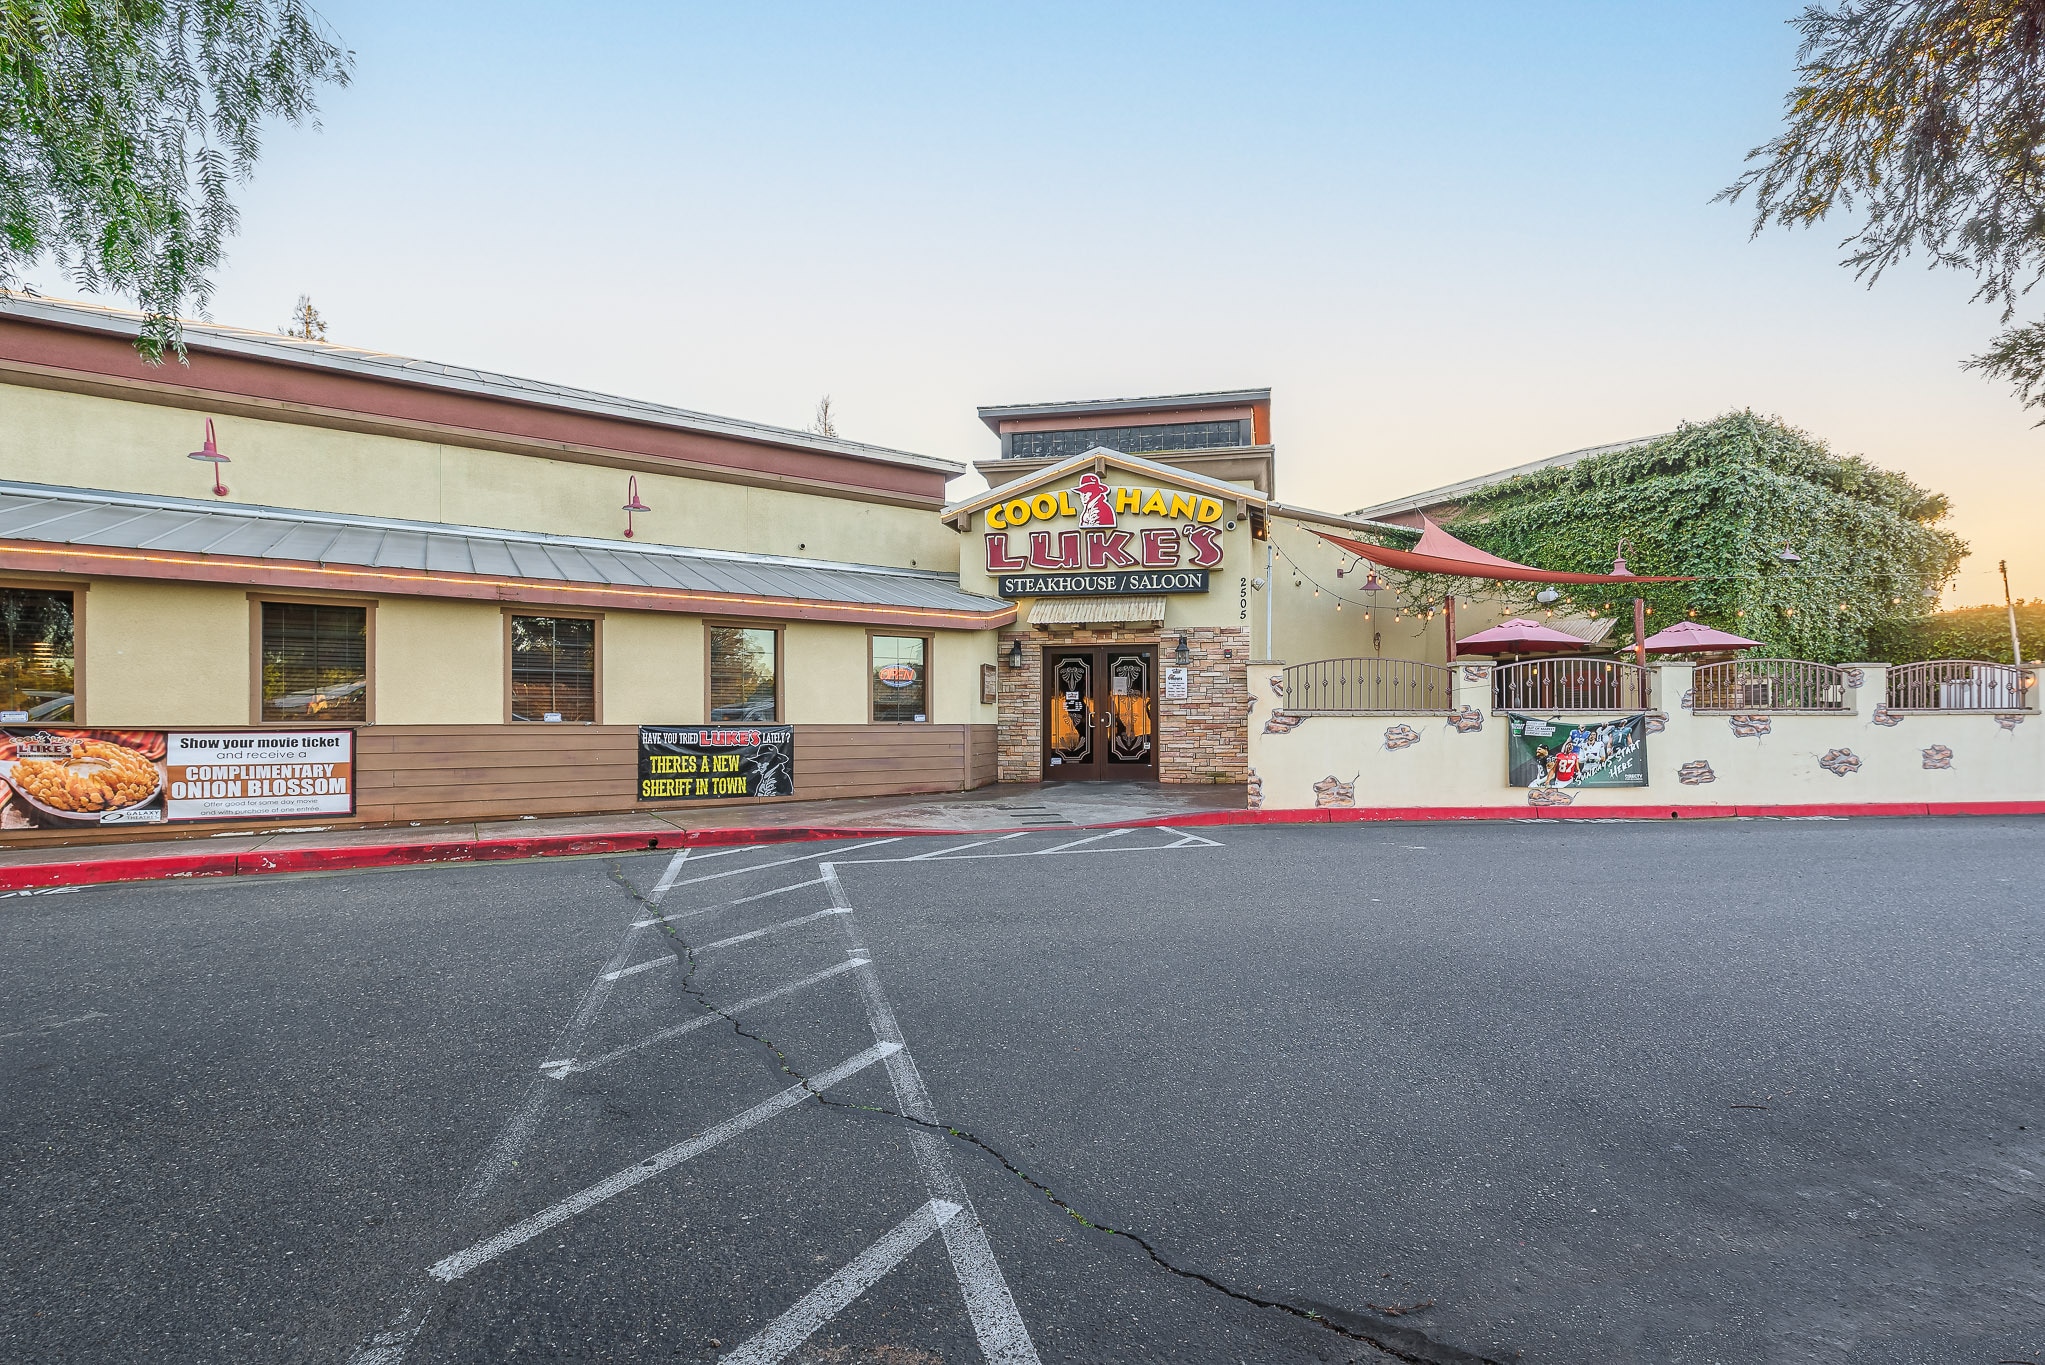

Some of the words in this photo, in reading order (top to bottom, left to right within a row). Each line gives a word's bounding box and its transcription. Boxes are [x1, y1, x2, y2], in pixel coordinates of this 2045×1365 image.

[986, 490, 1077, 529] COOL
[1115, 487, 1223, 523] HAND
[984, 524, 1223, 572] LUKE'S
[1005, 576, 1117, 593] STEAKHOUSE
[1120, 575, 1127, 591] /
[1130, 573, 1202, 590] SALOON
[879, 667, 914, 681] OPEN
[180, 737, 220, 749] Show
[222, 738, 254, 750] your
[257, 737, 299, 748] movie
[302, 736, 340, 747] ticket
[642, 732, 662, 745] HAVE
[663, 732, 678, 744] YOU
[679, 732, 698, 744] TRIED
[699, 730, 761, 747] LUKE'S
[762, 732, 790, 744] LATELY?
[216, 750, 243, 760] and
[246, 750, 294, 759] receive
[298, 751, 307, 759] a
[1616, 740, 1640, 762] START
[185, 764, 335, 781] COMPLIMENTARY
[650, 755, 697, 774] THERES
[700, 755, 710, 773] A
[712, 754, 740, 772] NEW
[1559, 759, 1576, 773] 87
[1609, 757, 1633, 779] HERE
[171, 780, 243, 799] ONION
[247, 777, 347, 797] BLOSSOM
[642, 778, 693, 797] SHERIFF
[695, 778, 709, 795] IN
[711, 777, 747, 795] TOWN
